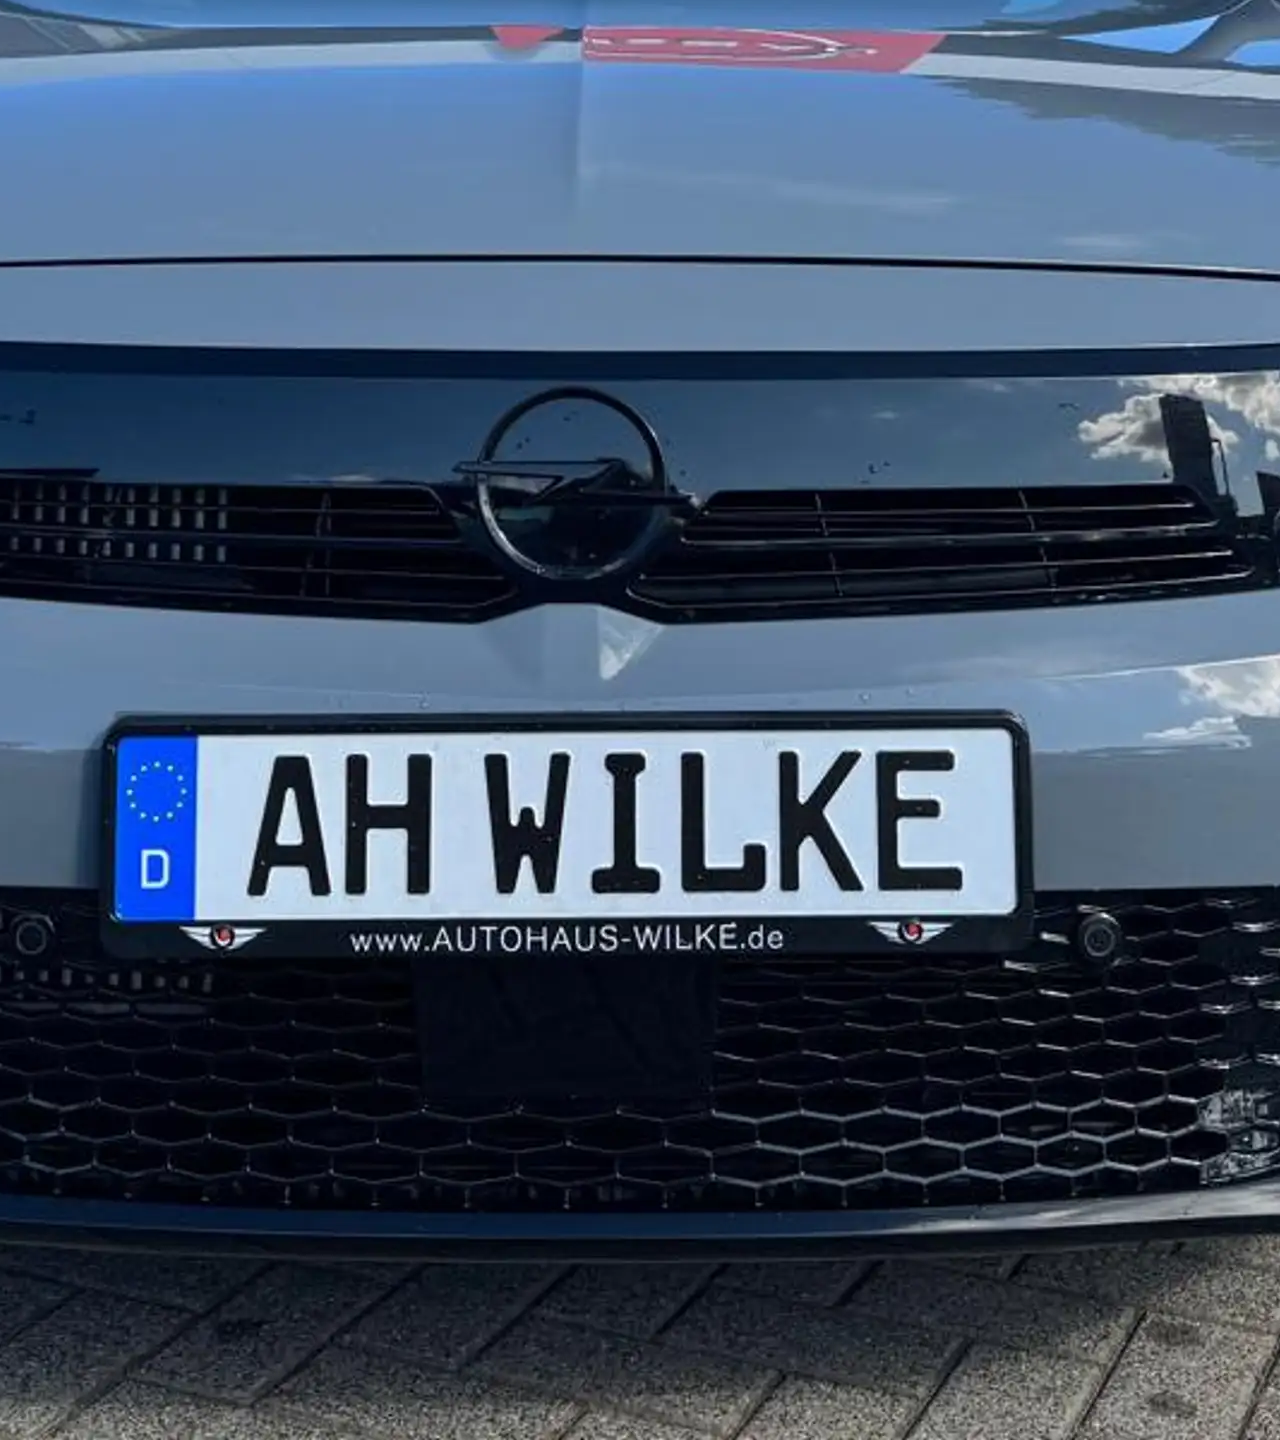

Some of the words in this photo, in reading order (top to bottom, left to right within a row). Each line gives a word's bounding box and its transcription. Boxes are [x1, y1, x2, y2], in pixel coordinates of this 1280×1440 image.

[246, 752, 432, 897] AH
[483, 748, 964, 895] WILKE
[140, 848, 170, 890] D
[349, 922, 785, 953] www.AUTOHAUS-WILKE.de
